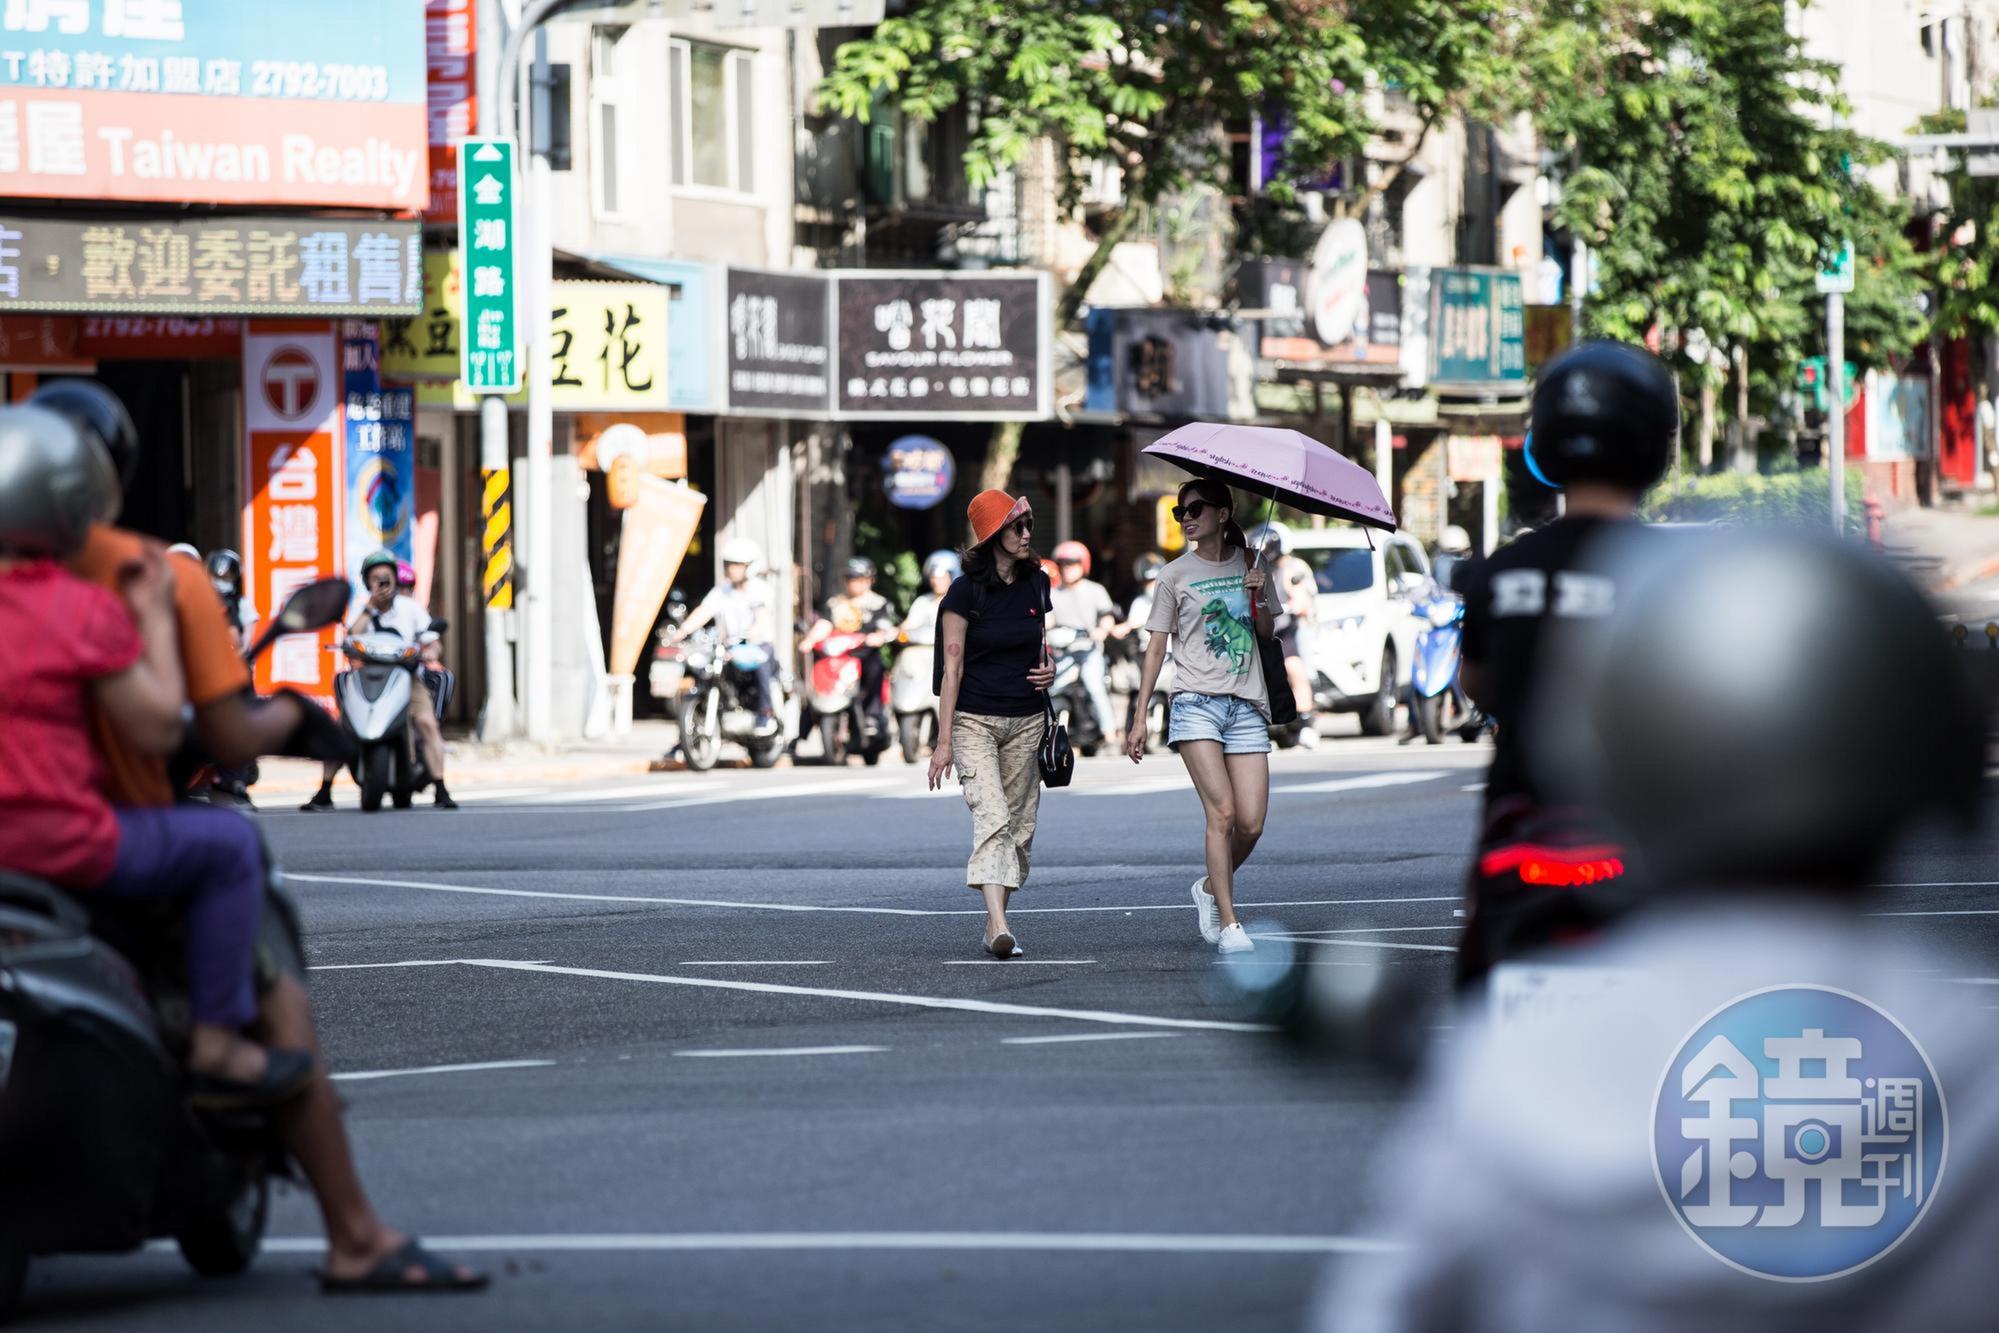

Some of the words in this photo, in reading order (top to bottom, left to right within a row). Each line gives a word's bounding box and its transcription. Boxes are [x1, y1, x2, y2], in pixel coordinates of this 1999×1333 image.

[252, 60, 388, 101] 2792-7003
[97, 127, 269, 182] Taiwan
[283, 134, 418, 198] Realty
[80, 226, 422, 303] 歡迎委託租售
[865, 349, 937, 367] SAVOUR
[938, 349, 1013, 367] FLOWER
